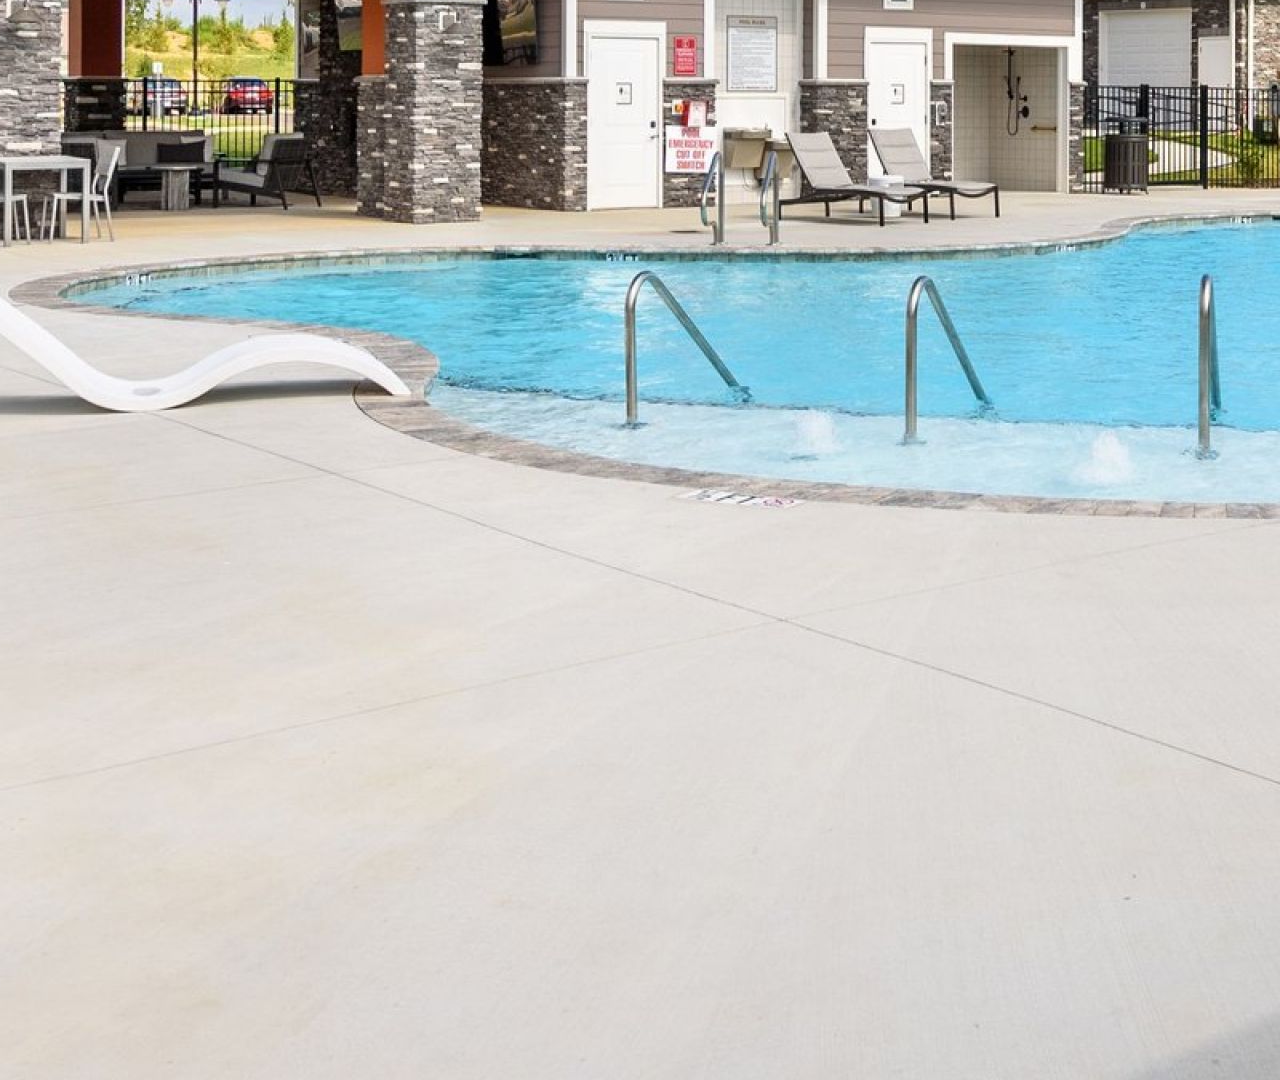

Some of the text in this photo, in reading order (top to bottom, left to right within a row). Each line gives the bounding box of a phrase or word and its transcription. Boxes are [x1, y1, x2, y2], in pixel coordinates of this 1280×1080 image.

[668, 139, 714, 149] EMERGENCY
[676, 150, 705, 160] CUT OFF
[676, 160, 705, 170] SWITCH
